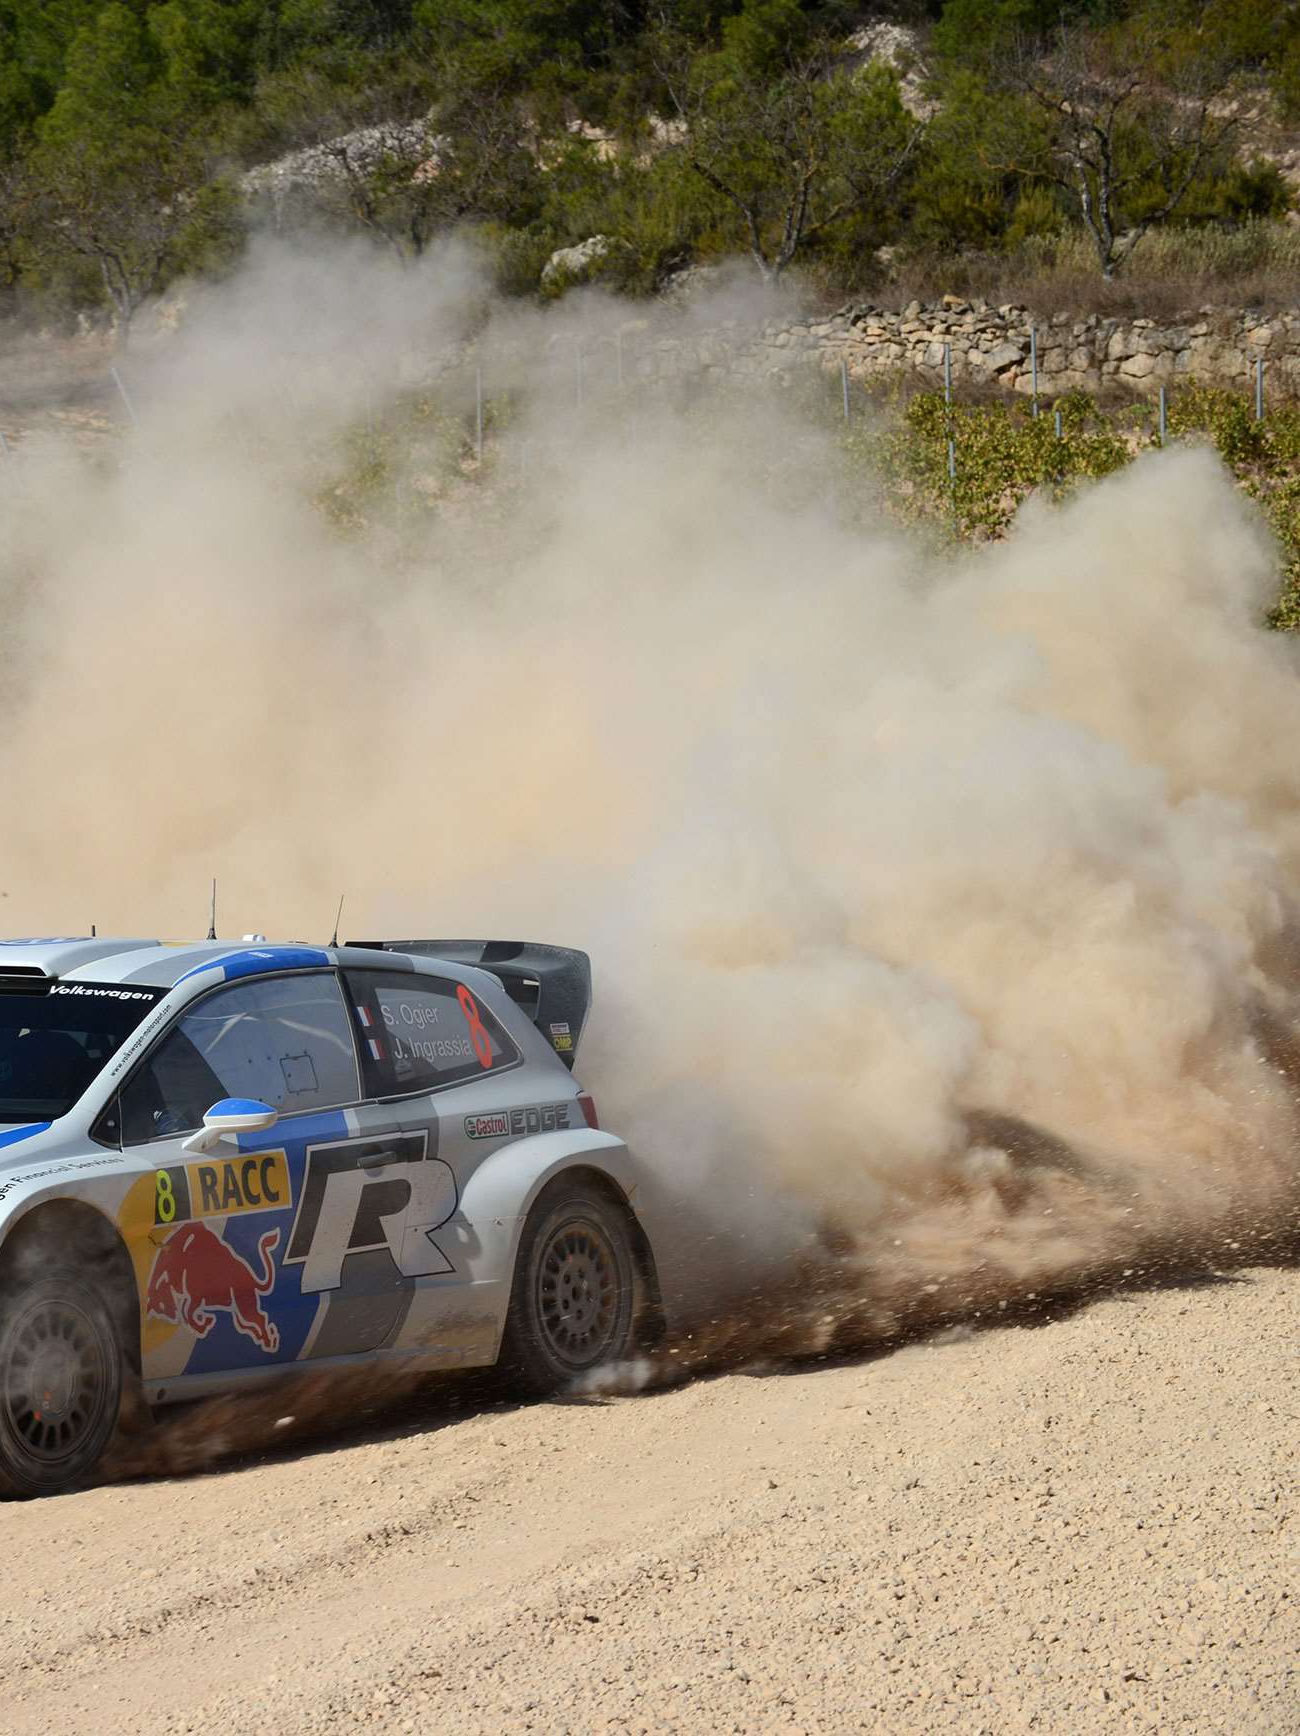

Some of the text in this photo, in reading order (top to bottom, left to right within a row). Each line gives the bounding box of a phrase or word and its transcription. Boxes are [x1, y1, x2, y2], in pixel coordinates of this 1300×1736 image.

[50, 985, 154, 1001] Volkswagen
[380, 1003, 439, 1029] S. Ogier
[456, 984, 492, 1069] 8
[394, 1034, 473, 1062] J. Ingrassia
[476, 1104, 571, 1136] Castrol EDGE
[155, 1169, 176, 1222] 8
[197, 1156, 280, 1212] RACC
